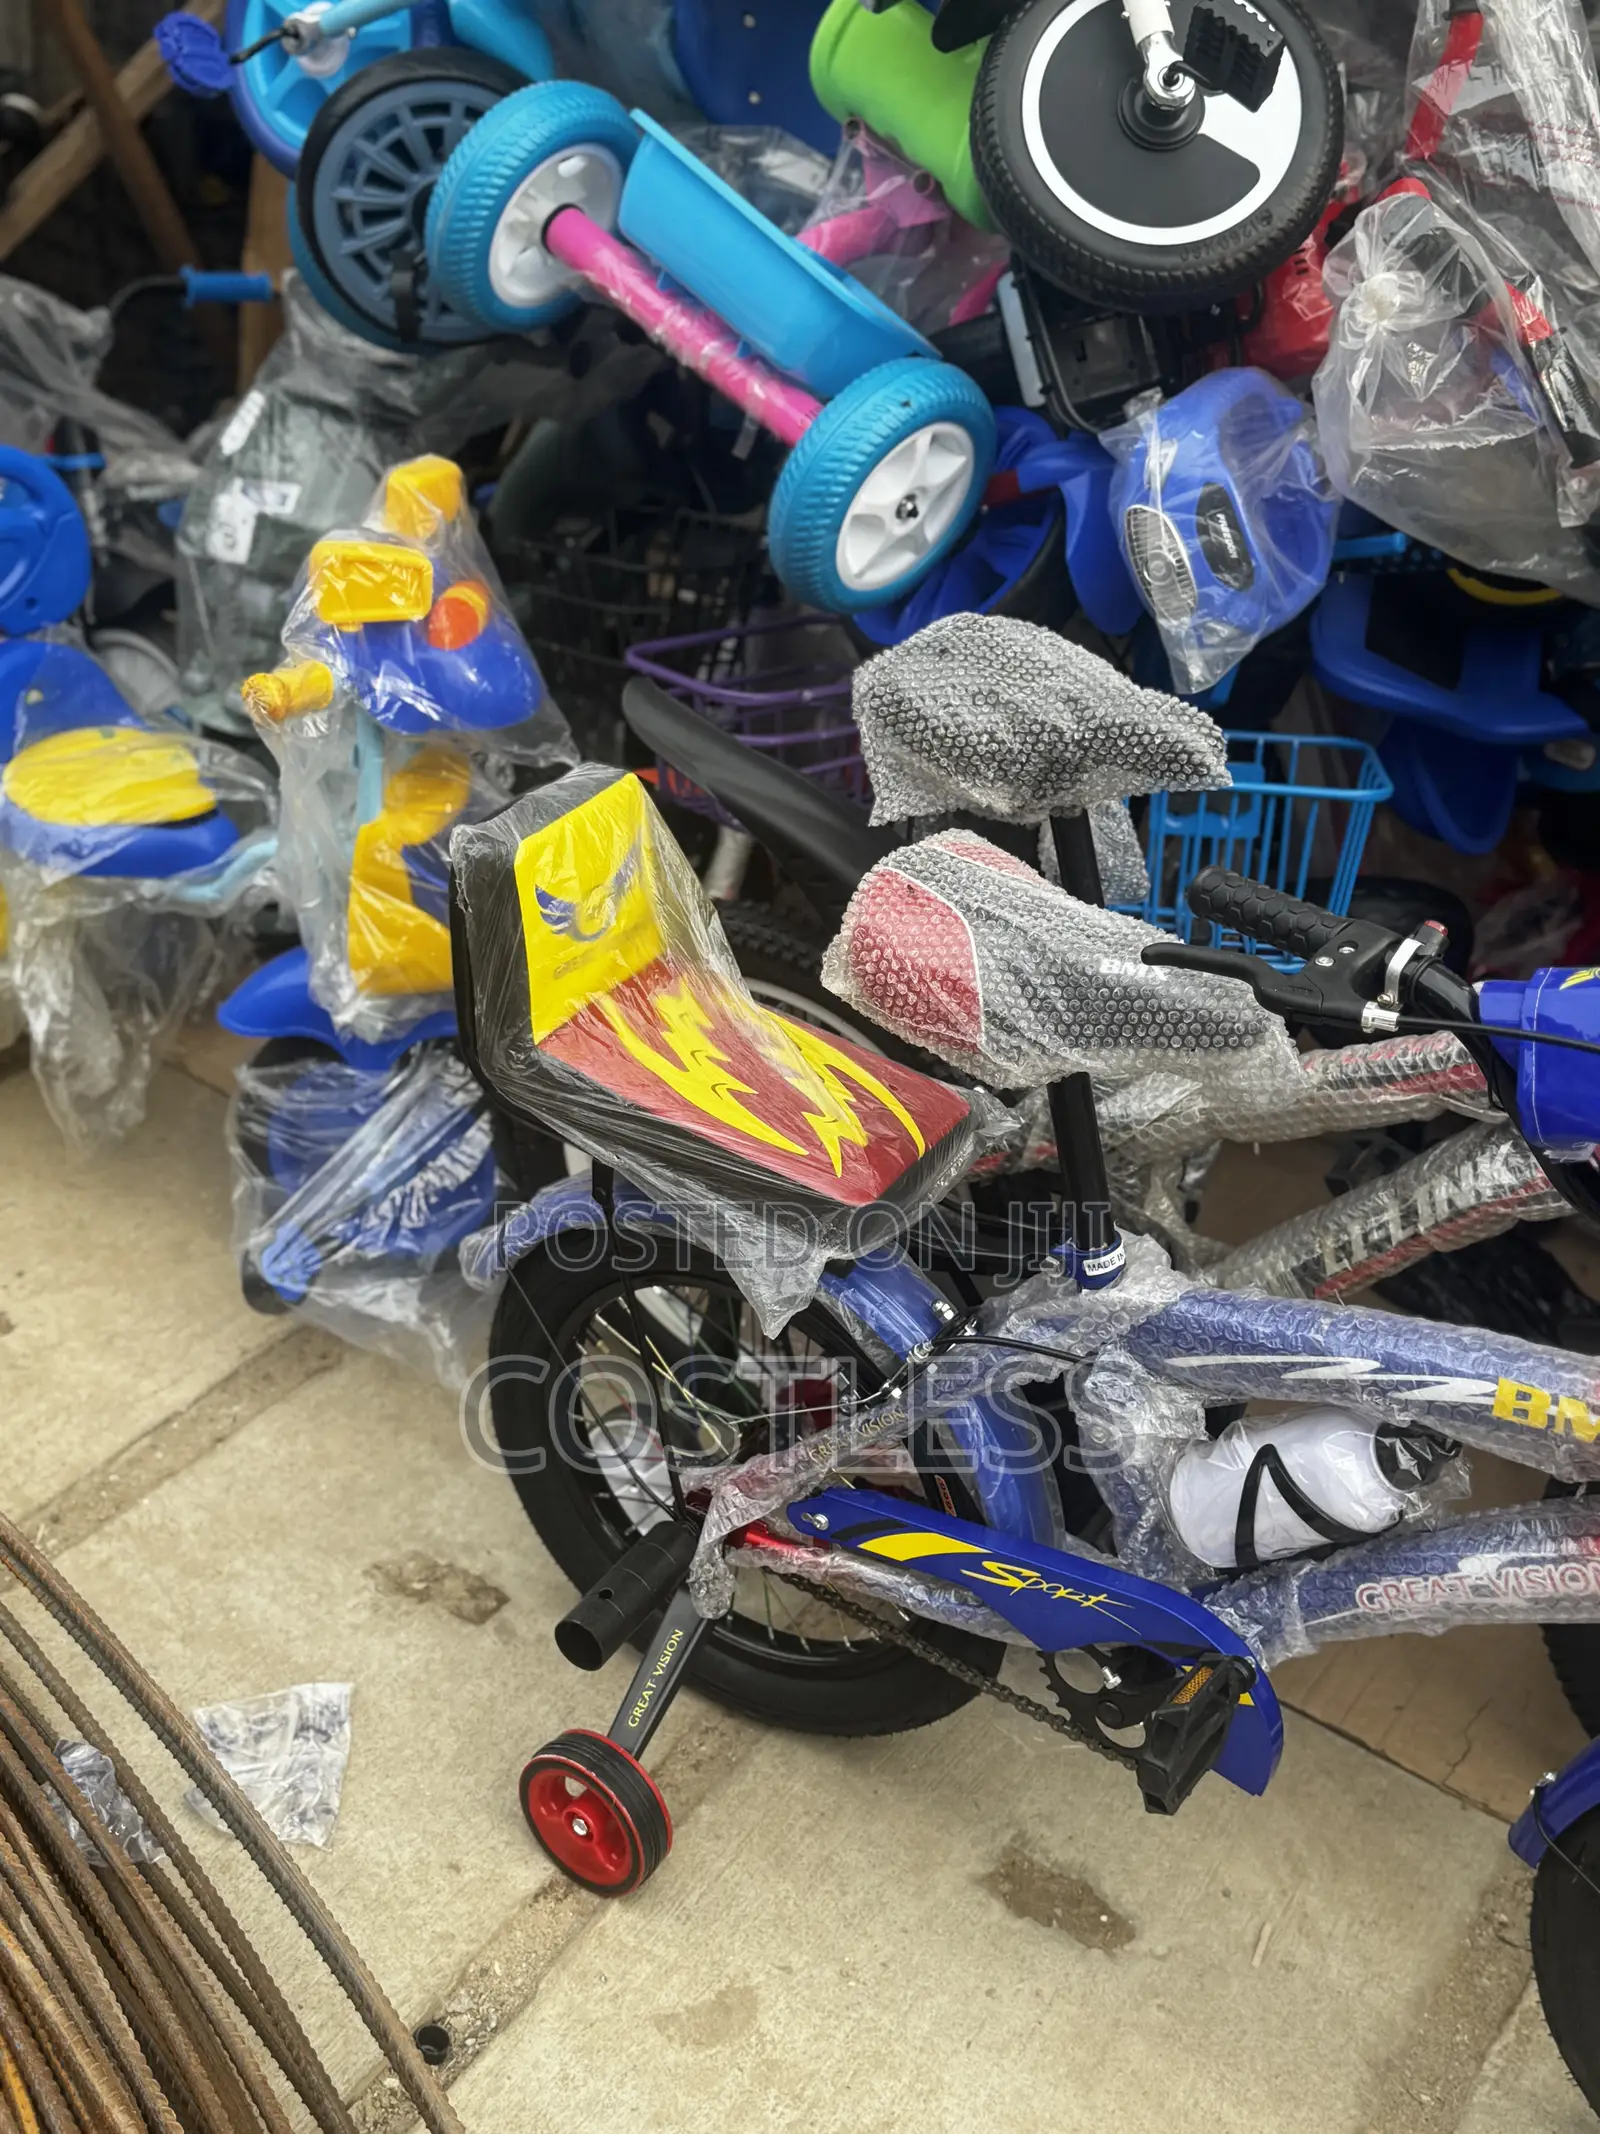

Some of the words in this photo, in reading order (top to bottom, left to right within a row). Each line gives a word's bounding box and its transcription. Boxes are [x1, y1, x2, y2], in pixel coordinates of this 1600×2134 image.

[1086, 1256, 1117, 1272] MADE
[856, 1408, 908, 1438] VISION
[960, 1561, 1141, 1635] Sport
[1355, 1573, 1474, 1613] GREAT
[628, 1678, 657, 1728] GREAT
[652, 1629, 684, 1676] VISION
